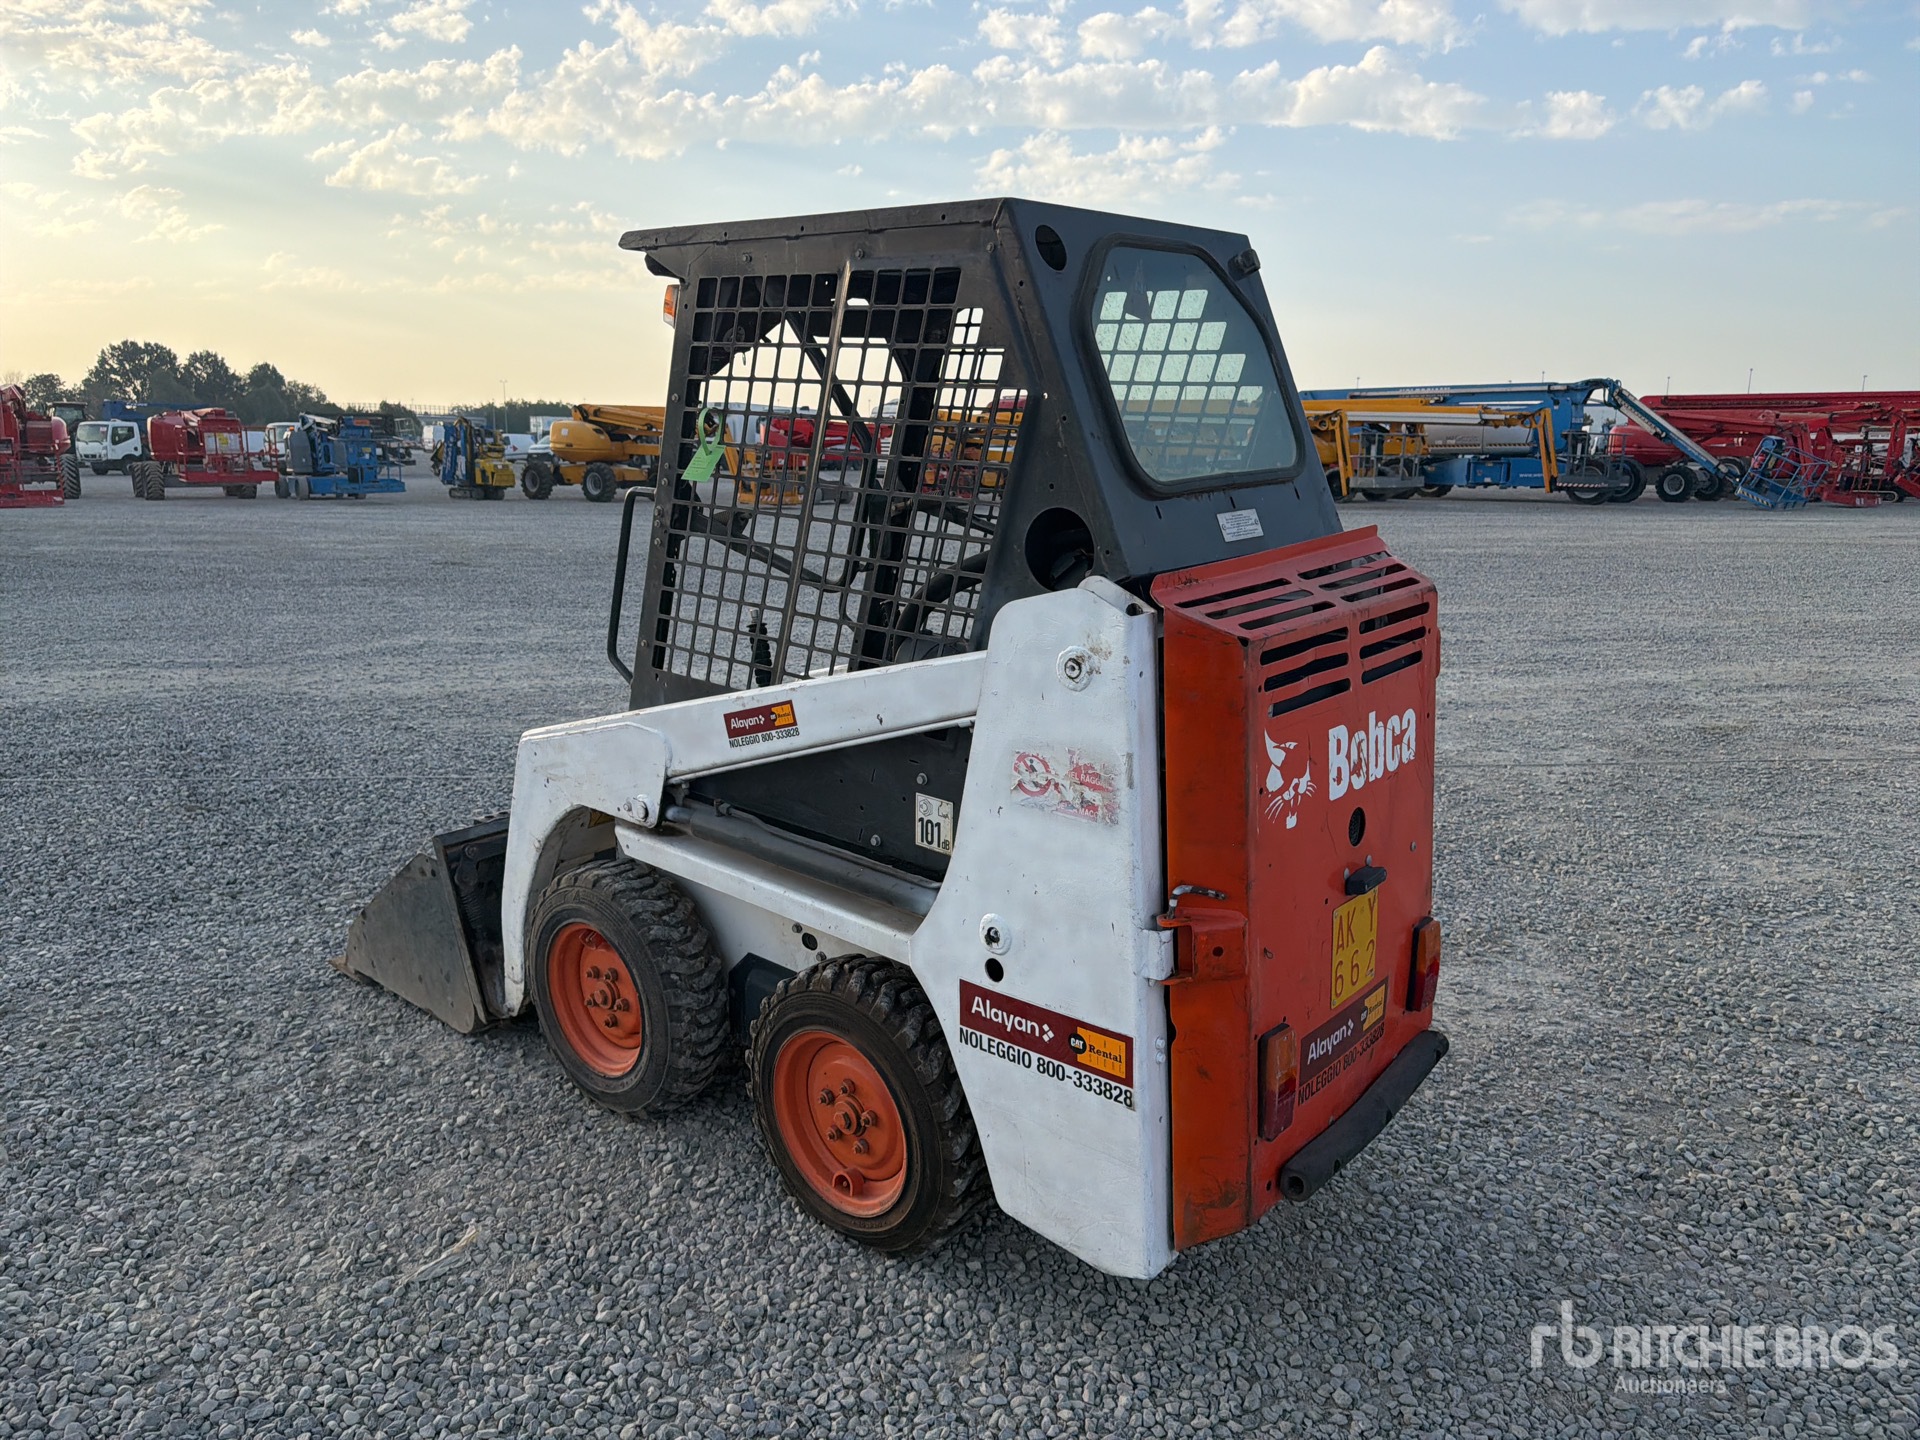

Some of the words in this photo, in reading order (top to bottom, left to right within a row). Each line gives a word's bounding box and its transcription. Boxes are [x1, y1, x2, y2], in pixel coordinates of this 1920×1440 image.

[729, 734, 761, 749] NOLEGGIO
[761, 727, 800, 743] 800-333828
[730, 716, 760, 730] Alayan
[918, 816, 941, 848] 101
[941, 838, 950, 851] dB
[1336, 906, 1356, 956] AK
[1367, 894, 1377, 933] Y
[971, 995, 1040, 1038] Alayan
[1070, 1036, 1084, 1049] CAT
[1088, 1043, 1122, 1064] Rental
[1307, 1024, 1347, 1065] Alayan
[959, 1026, 1032, 1069] NOLEGGIO
[1036, 1056, 1133, 1108] 800-333828
[1298, 1059, 1342, 1106] NOLEGGIO
